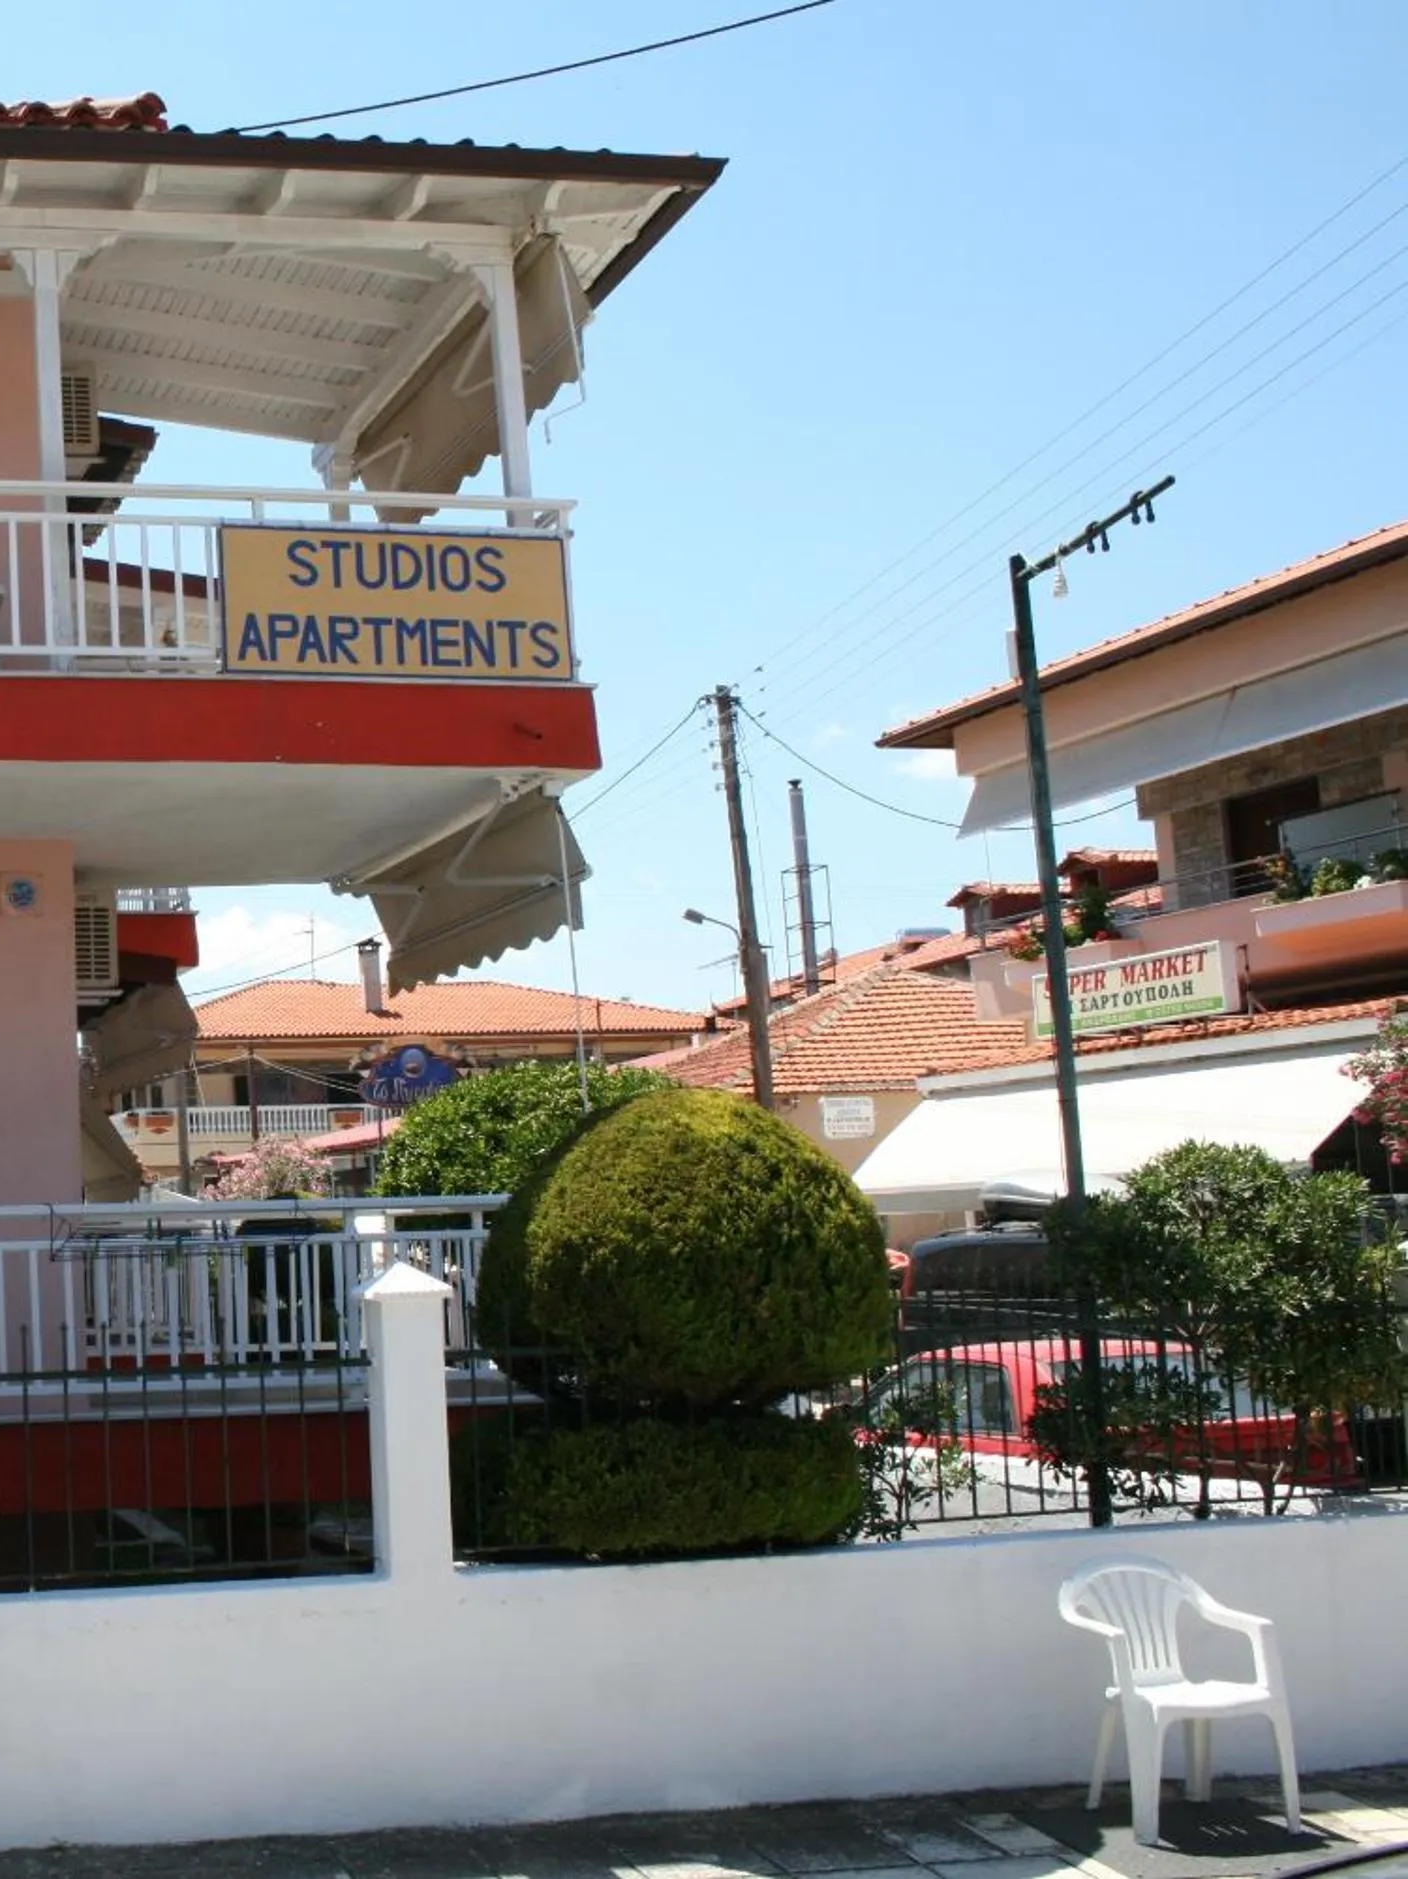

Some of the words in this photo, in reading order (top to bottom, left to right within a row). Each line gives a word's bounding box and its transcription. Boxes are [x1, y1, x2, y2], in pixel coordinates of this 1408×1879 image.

[286, 540, 507, 593] STUDIOS
[238, 613, 560, 668] APARTMENTS
[1044, 969, 1106, 999] PER
[1120, 950, 1208, 986] MARKET
